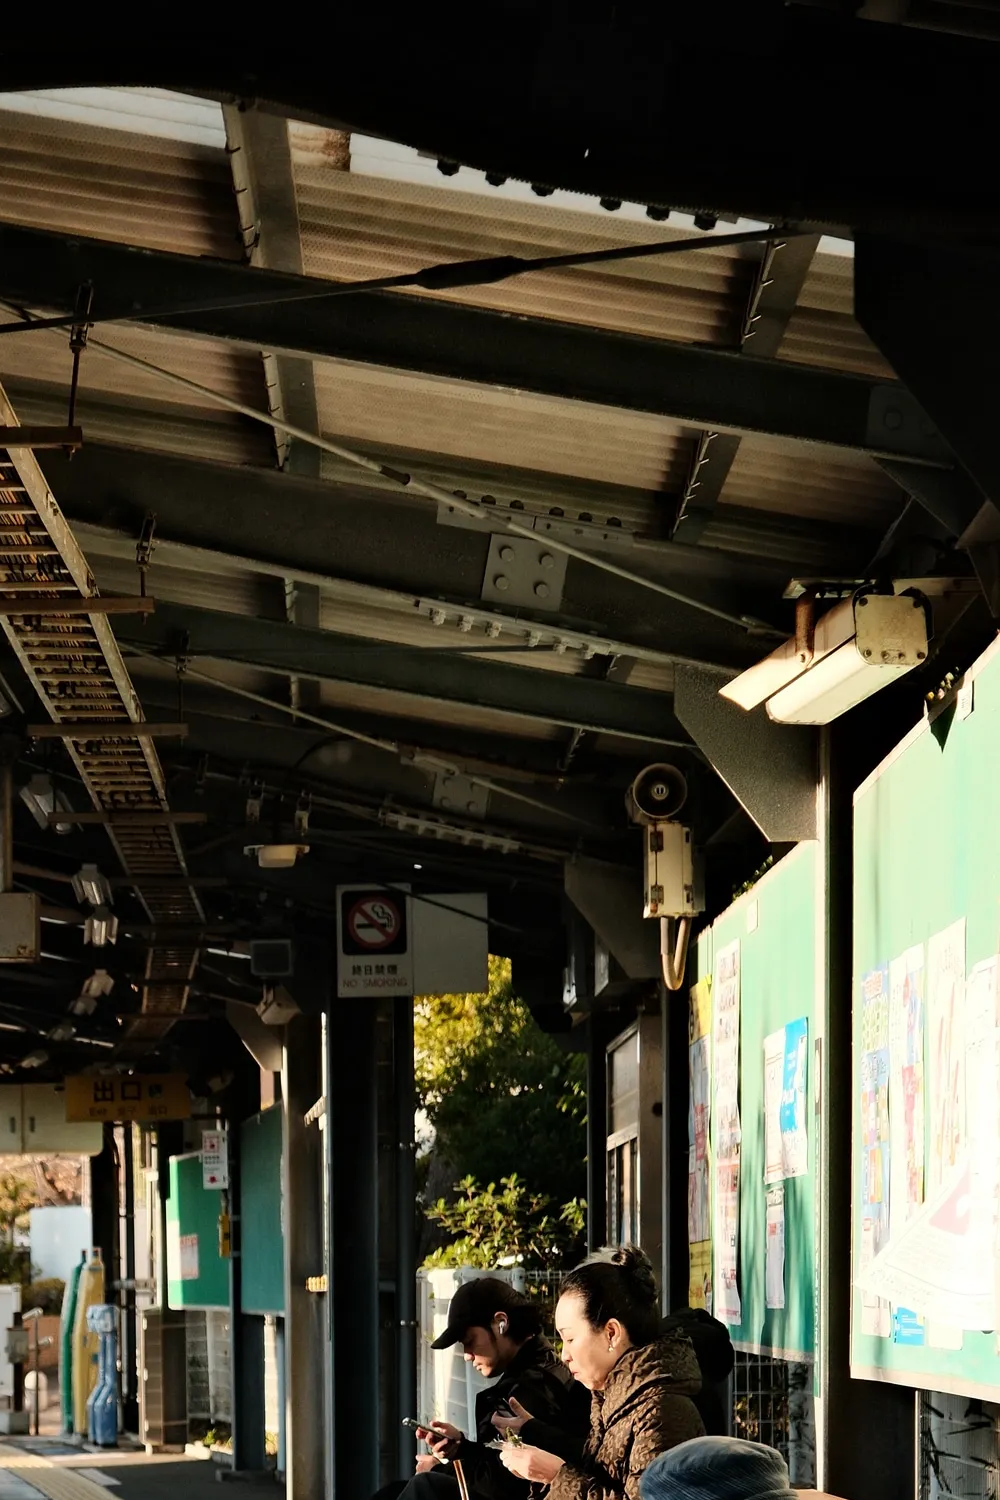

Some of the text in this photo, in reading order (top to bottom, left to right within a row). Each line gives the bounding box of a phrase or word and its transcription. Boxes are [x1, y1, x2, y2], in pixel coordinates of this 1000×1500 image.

[343, 977, 408, 988] NO SMOKING
[94, 1080, 142, 1102] 出口
